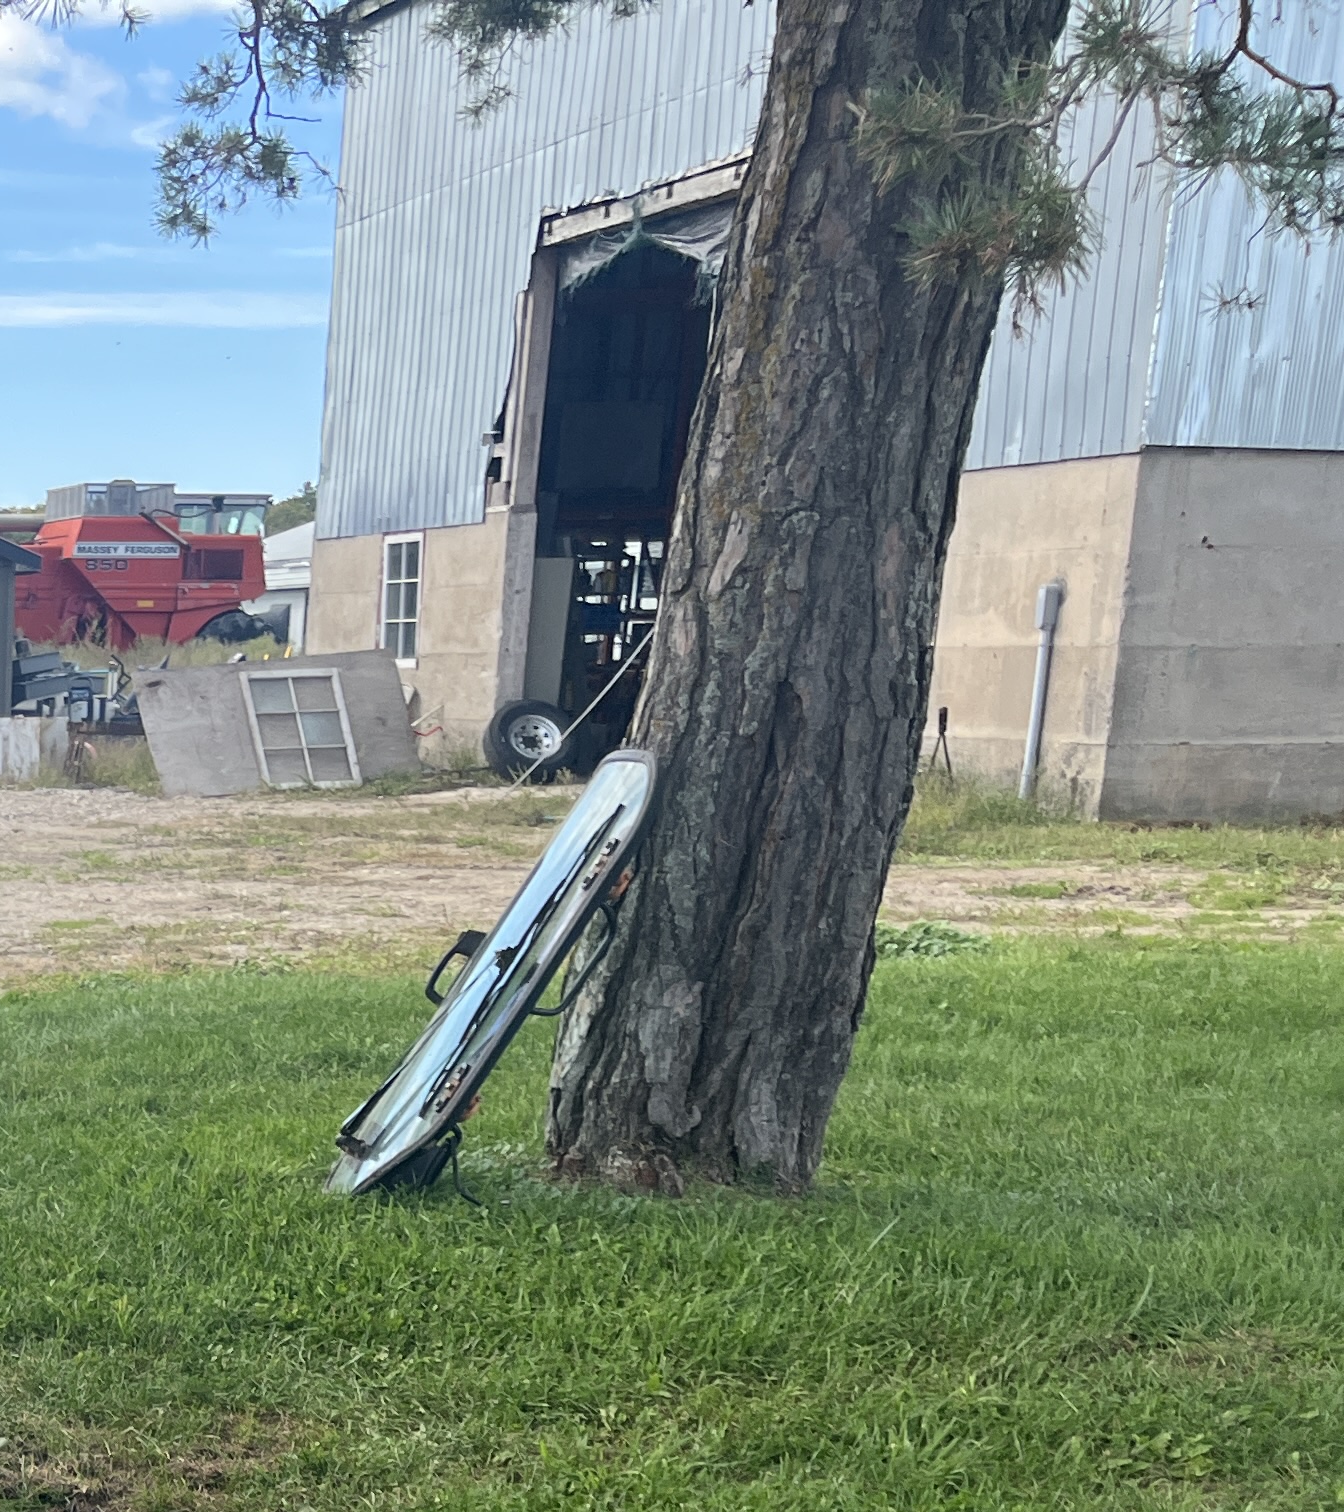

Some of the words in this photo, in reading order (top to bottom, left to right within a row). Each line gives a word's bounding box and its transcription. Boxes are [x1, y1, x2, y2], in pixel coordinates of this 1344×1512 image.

[77, 546, 119, 554] MASSEY
[124, 546, 178, 554] FERGUSON
[85, 560, 128, 571] 850
